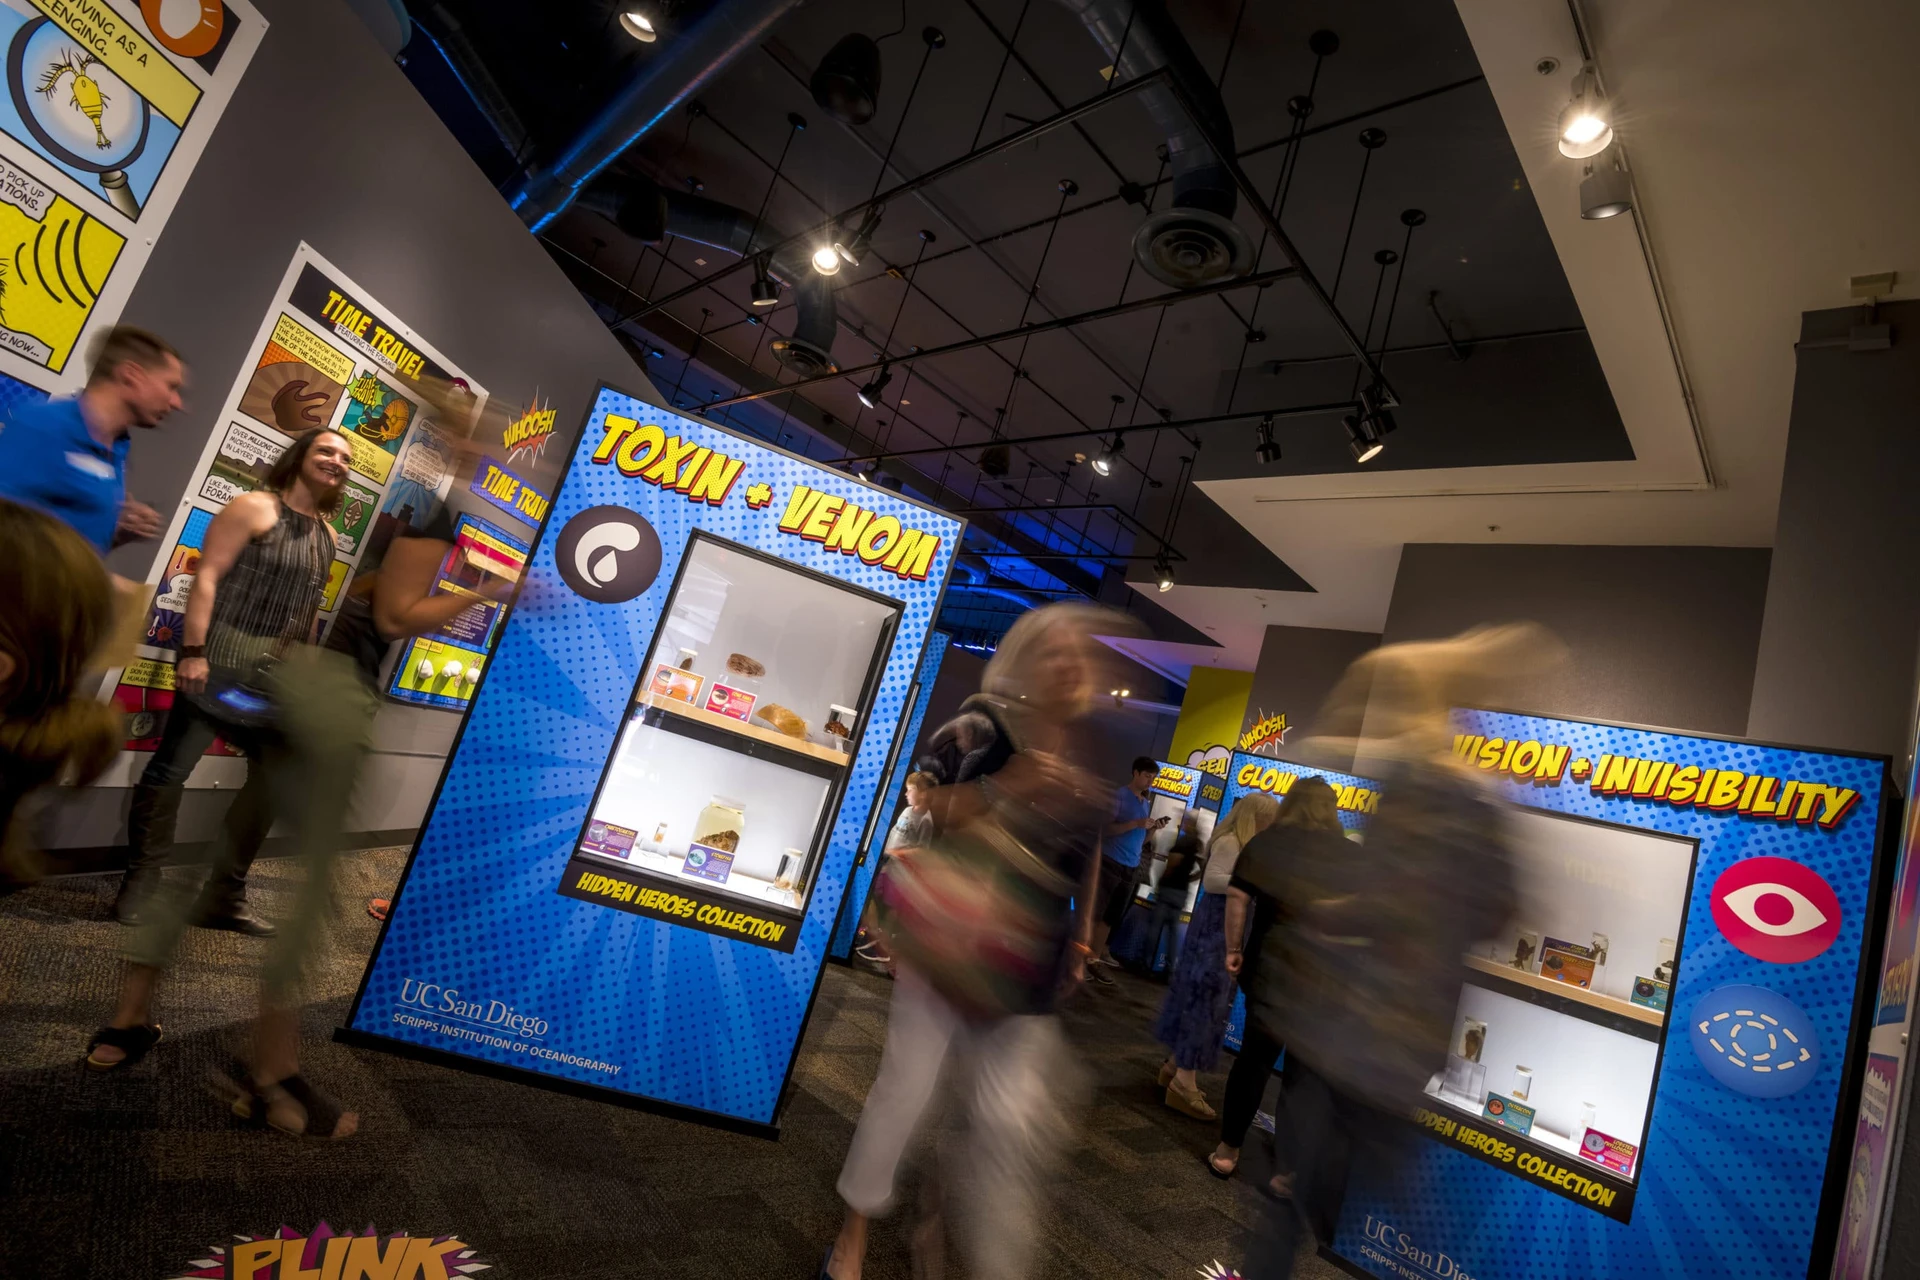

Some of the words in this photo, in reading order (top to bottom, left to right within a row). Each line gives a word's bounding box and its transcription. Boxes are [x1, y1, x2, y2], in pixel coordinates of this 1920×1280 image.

[69, 0, 116, 37] IVING
[116, 35, 137, 55] AS
[137, 53, 148, 67] A
[6, 171, 29, 191] PICK
[30, 186, 45, 198] UP
[8, 336, 39, 357] NOW...
[275, 332, 288, 344] TIME
[289, 341, 297, 350] OF
[298, 347, 309, 359] THE
[308, 355, 340, 379] DINOSAURS?
[278, 326, 290, 336] THE
[290, 332, 308, 348] EARTH
[308, 344, 320, 355] WAS
[320, 352, 331, 364] LIKE
[331, 361, 338, 370] IN
[338, 365, 348, 375] THE
[281, 318, 295, 330] HOW
[296, 328, 305, 337] DO
[305, 333, 314, 343] WE
[314, 339, 330, 353] KNOW
[330, 351, 346, 365] WHAT
[321, 290, 373, 338] TIME
[370, 326, 425, 380] TRAVEL
[337, 324, 366, 348] FEATURING
[366, 345, 376, 356] THE
[375, 352, 396, 371] FORAMS
[359, 377, 377, 389] TIME
[229, 435, 266, 458] MICROFOSSILS
[267, 454, 279, 463] ARE
[232, 427, 248, 439] OVER
[249, 435, 272, 453] MILLIONS
[272, 446, 281, 455] OF
[503, 409, 557, 450] WHOOSH
[232, 445, 254, 461] LAYERS
[209, 479, 221, 488] LIKE
[221, 483, 232, 494] ME,
[481, 465, 520, 503] TIME
[515, 486, 549, 522] TRAV
[592, 413, 746, 507] TOXIN
[745, 482, 773, 510] +
[778, 485, 941, 581] VENOM
[1240, 713, 1287, 750] WHOOSH
[1159, 767, 1185, 780] SPEED
[1185, 774, 1192, 782] +
[1197, 757, 1228, 774] SEA
[1236, 763, 1299, 795] GLOW
[1451, 733, 1570, 784] VISION
[1570, 757, 1593, 781] +
[1590, 753, 1862, 829] INVISIBILITY
[1151, 777, 1192, 797] STRENGTH
[1201, 784, 1223, 802] SPEED
[576, 871, 635, 902] HIDDEN
[634, 885, 695, 918] HEROES
[696, 904, 785, 942] COLLECTION
[400, 977, 441, 1010] UC
[439, 989, 484, 1020] San
[485, 999, 549, 1038] Diego
[392, 1012, 440, 1033] SCRIPPS
[440, 1023, 511, 1050] INSTITUTION
[512, 1040, 529, 1054] OF
[529, 1045, 621, 1076] OCEANOGRAPHY
[1456, 1125, 1517, 1163] HEROES
[1517, 1152, 1617, 1208] COLLECTION
[232, 1236, 469, 1280] PLINK
[1360, 1245, 1397, 1271] SCRIPPS
[1398, 1265, 1426, 1280] INST
[1364, 1214, 1396, 1248] UC
[1395, 1233, 1432, 1269] San
[1433, 1252, 1476, 1280] Die
